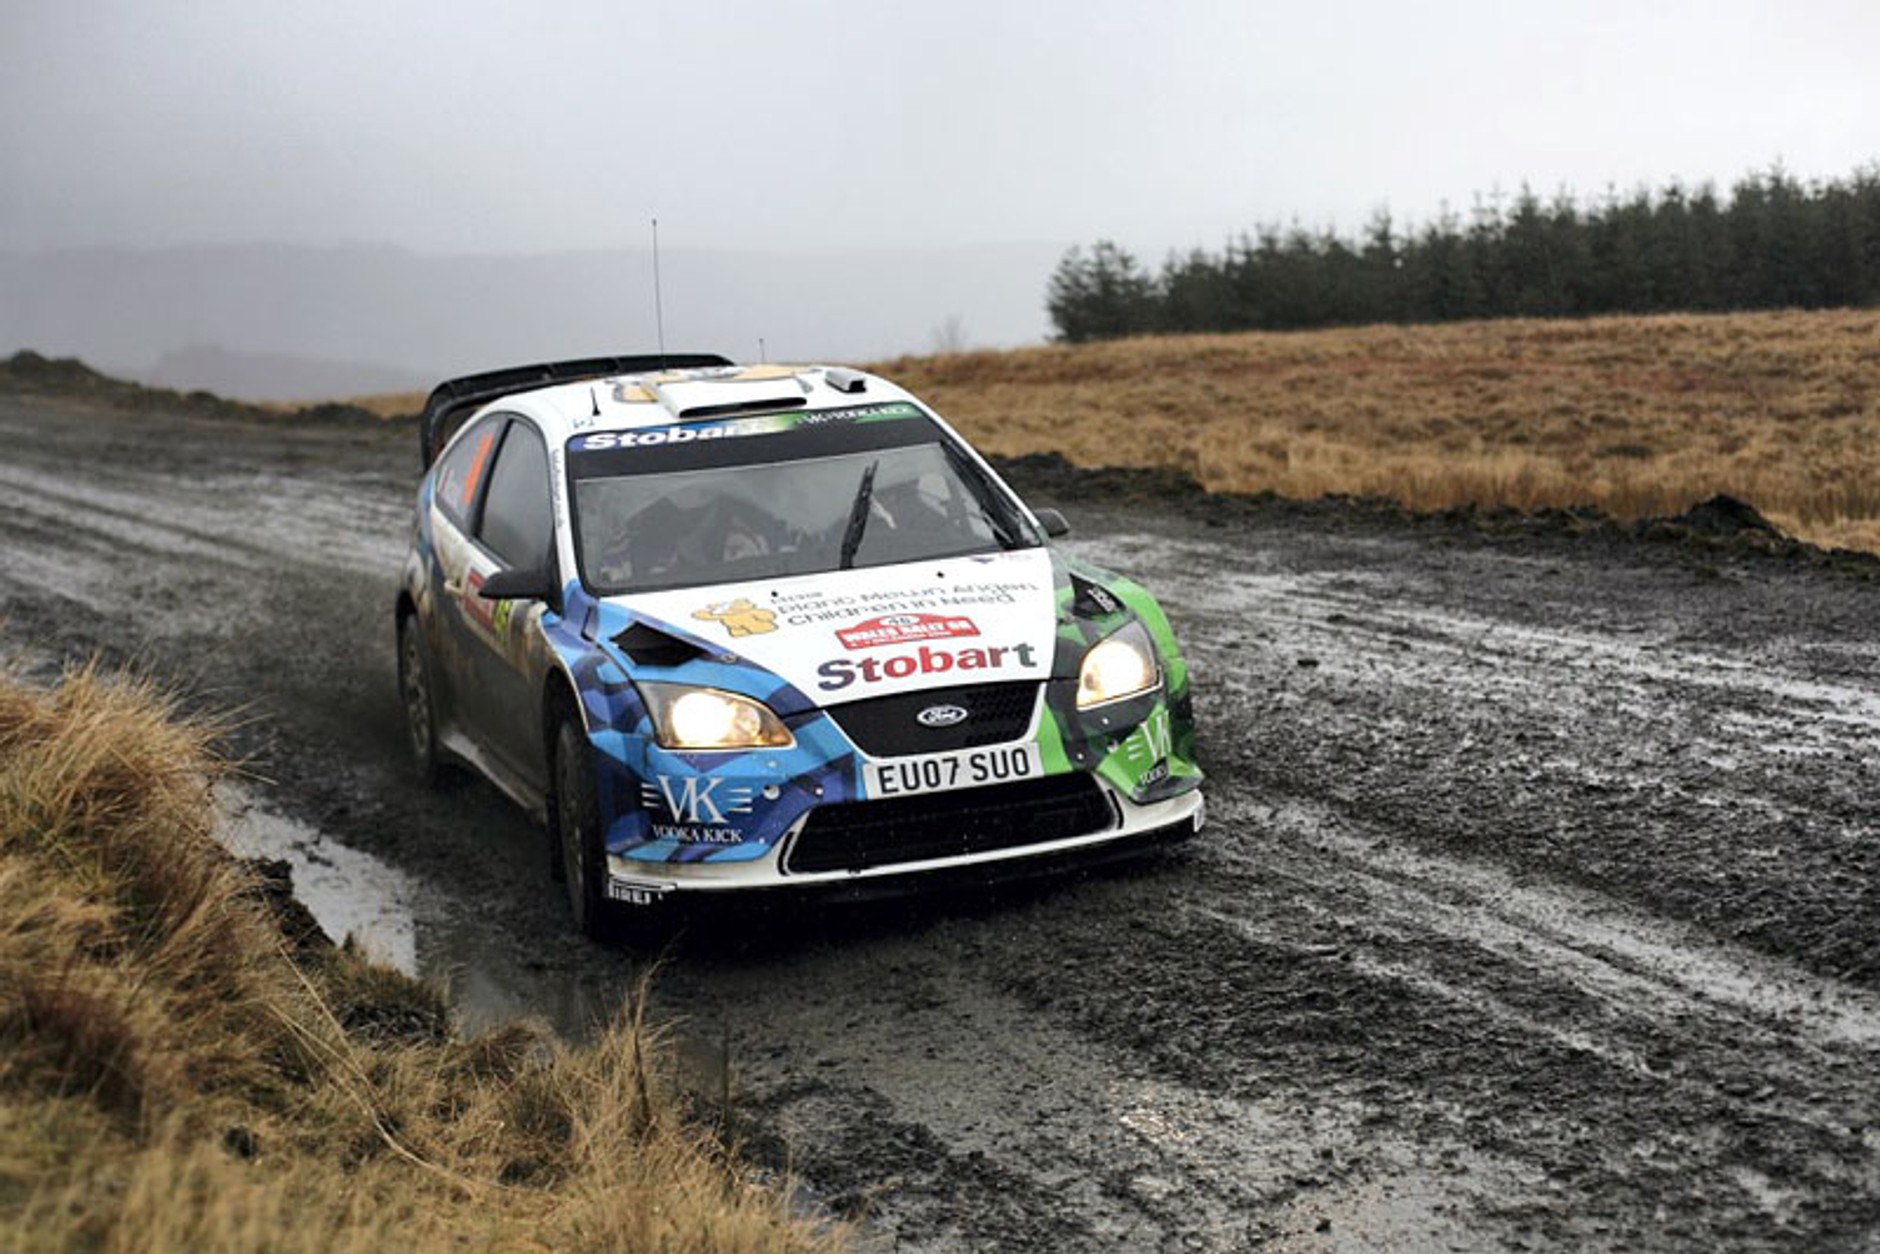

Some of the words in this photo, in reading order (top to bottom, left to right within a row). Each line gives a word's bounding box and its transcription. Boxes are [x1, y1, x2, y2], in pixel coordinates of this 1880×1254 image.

[817, 642, 1038, 692] Stobart
[878, 757, 961, 795] EU07
[971, 747, 1031, 782] SUO
[656, 774, 731, 824] VK
[652, 824, 700, 843] VODKA
[703, 828, 744, 843] KICK
